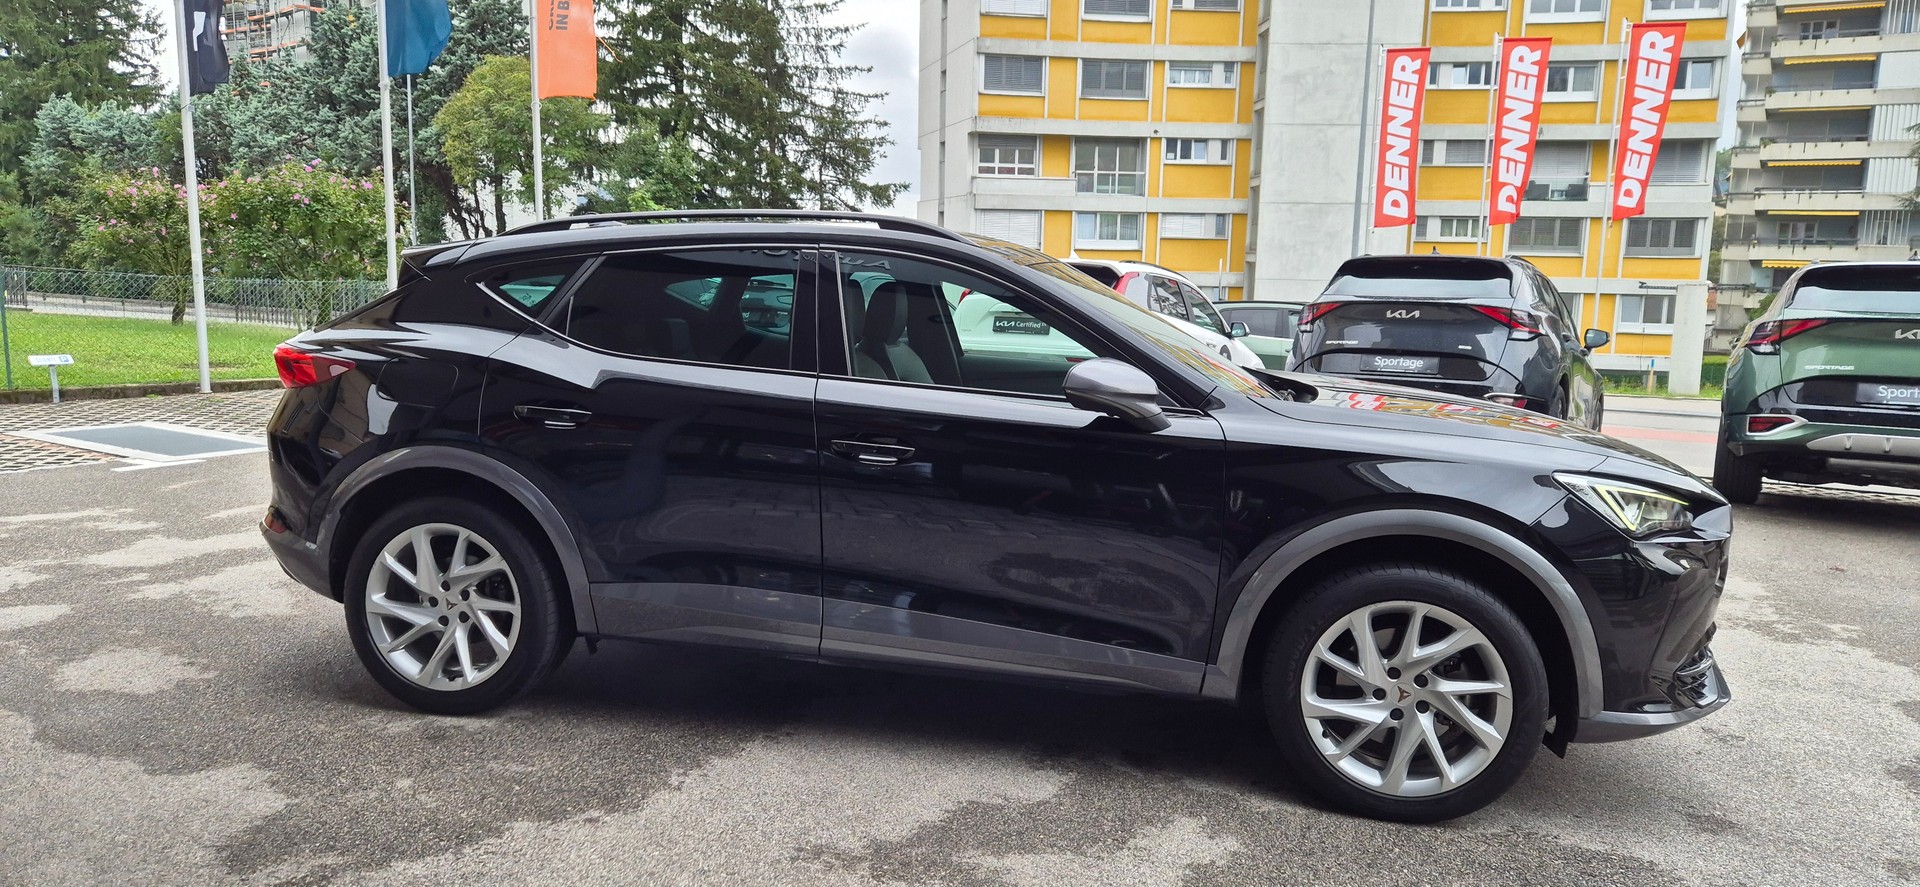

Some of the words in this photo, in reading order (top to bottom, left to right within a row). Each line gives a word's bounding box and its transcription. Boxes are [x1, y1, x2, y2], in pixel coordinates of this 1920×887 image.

[556, 14, 568, 30] IN
[1616, 31, 1676, 208] DENNER
[1382, 55, 1422, 219] DENNER
[1497, 45, 1542, 213] DENNER
[1386, 309, 1420, 319] KIA
[1374, 356, 1424, 368] Sportage
[1878, 385, 1920, 399] Sport
